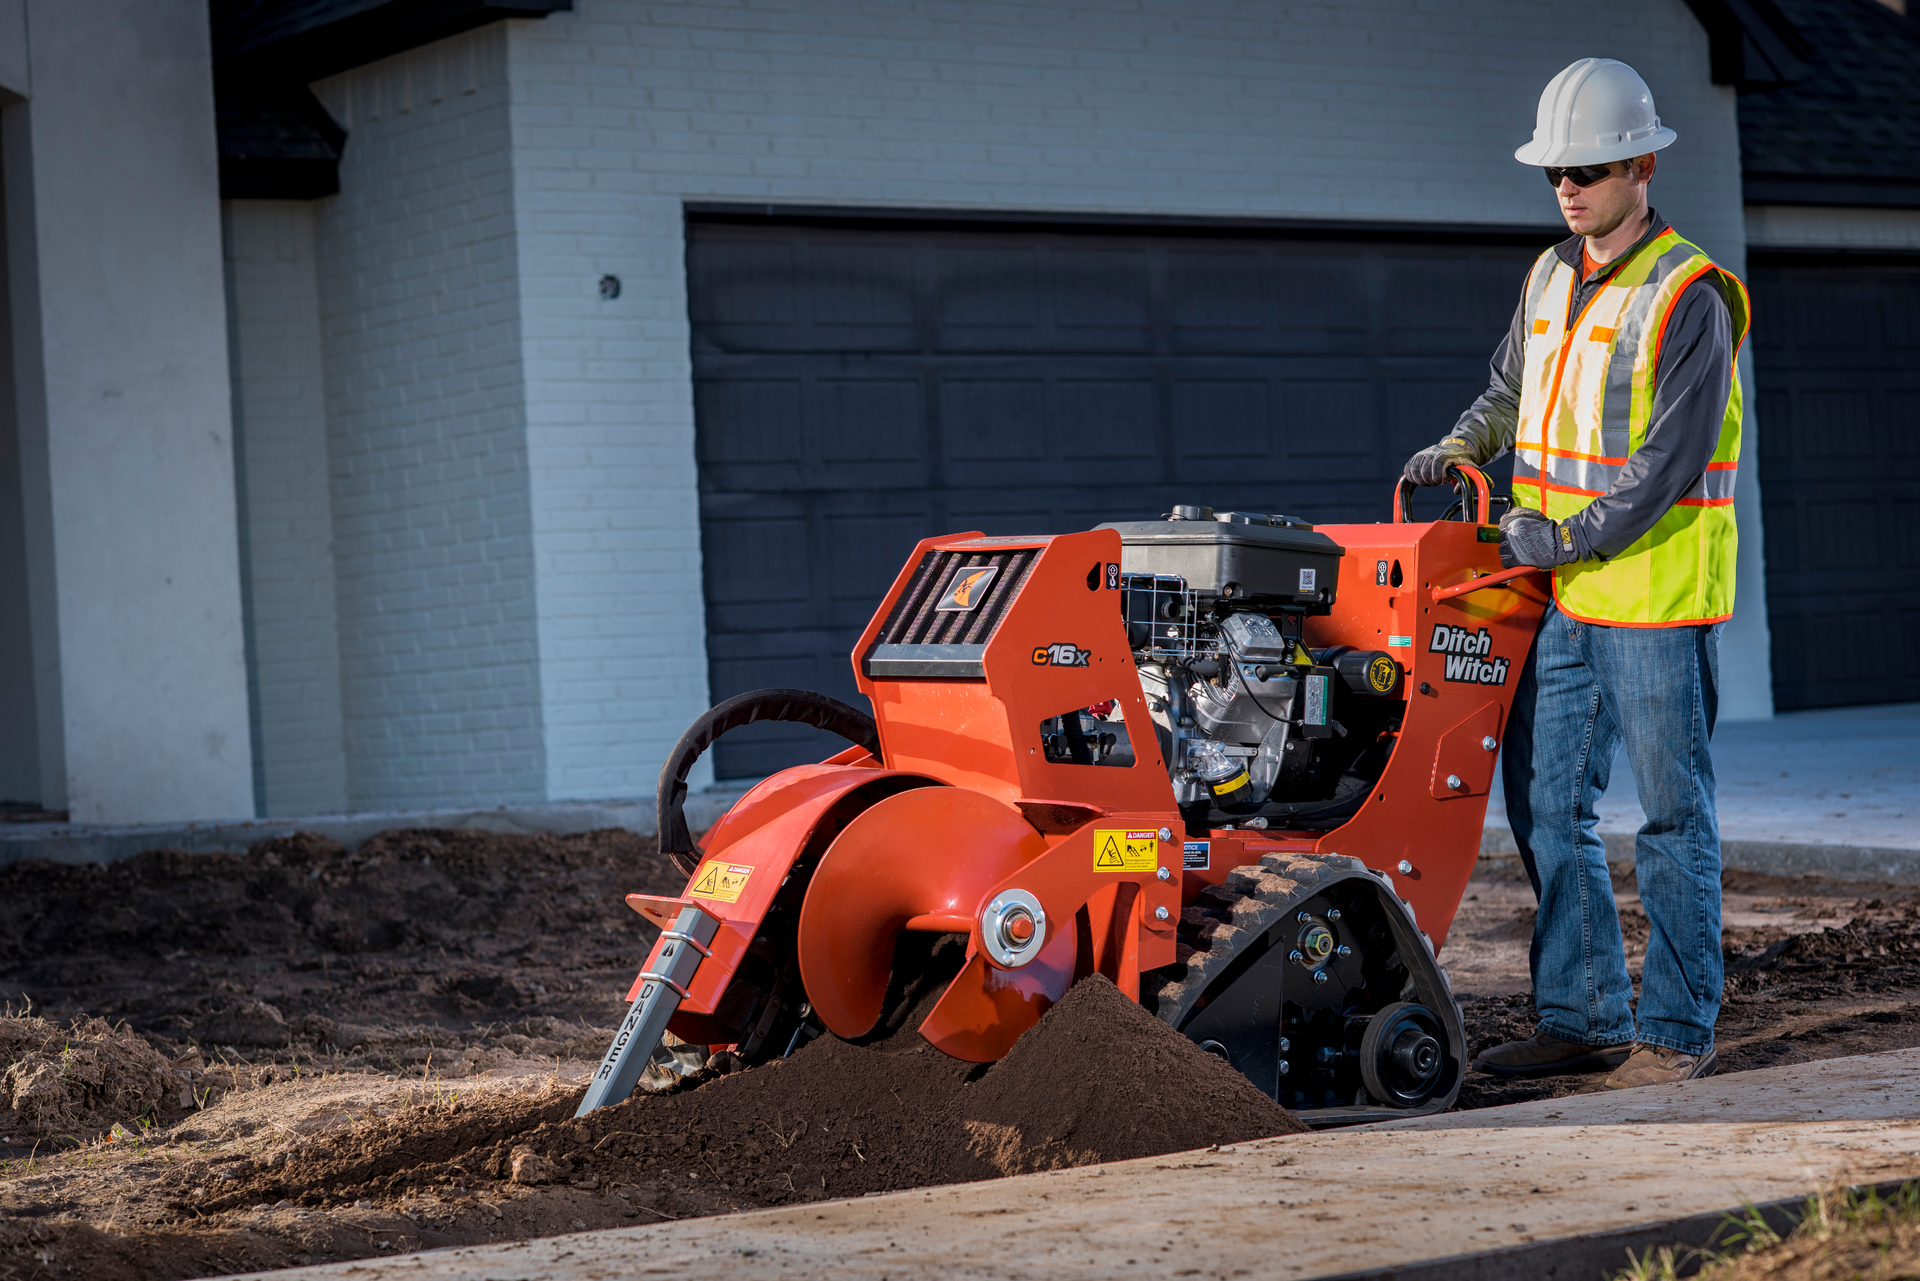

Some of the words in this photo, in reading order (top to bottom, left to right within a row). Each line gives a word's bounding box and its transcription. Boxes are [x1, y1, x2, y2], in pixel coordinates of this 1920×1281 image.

[1431, 626, 1491, 655] Ditch
[1446, 655, 1507, 683] Witch
[598, 983, 655, 1080] DANGER
